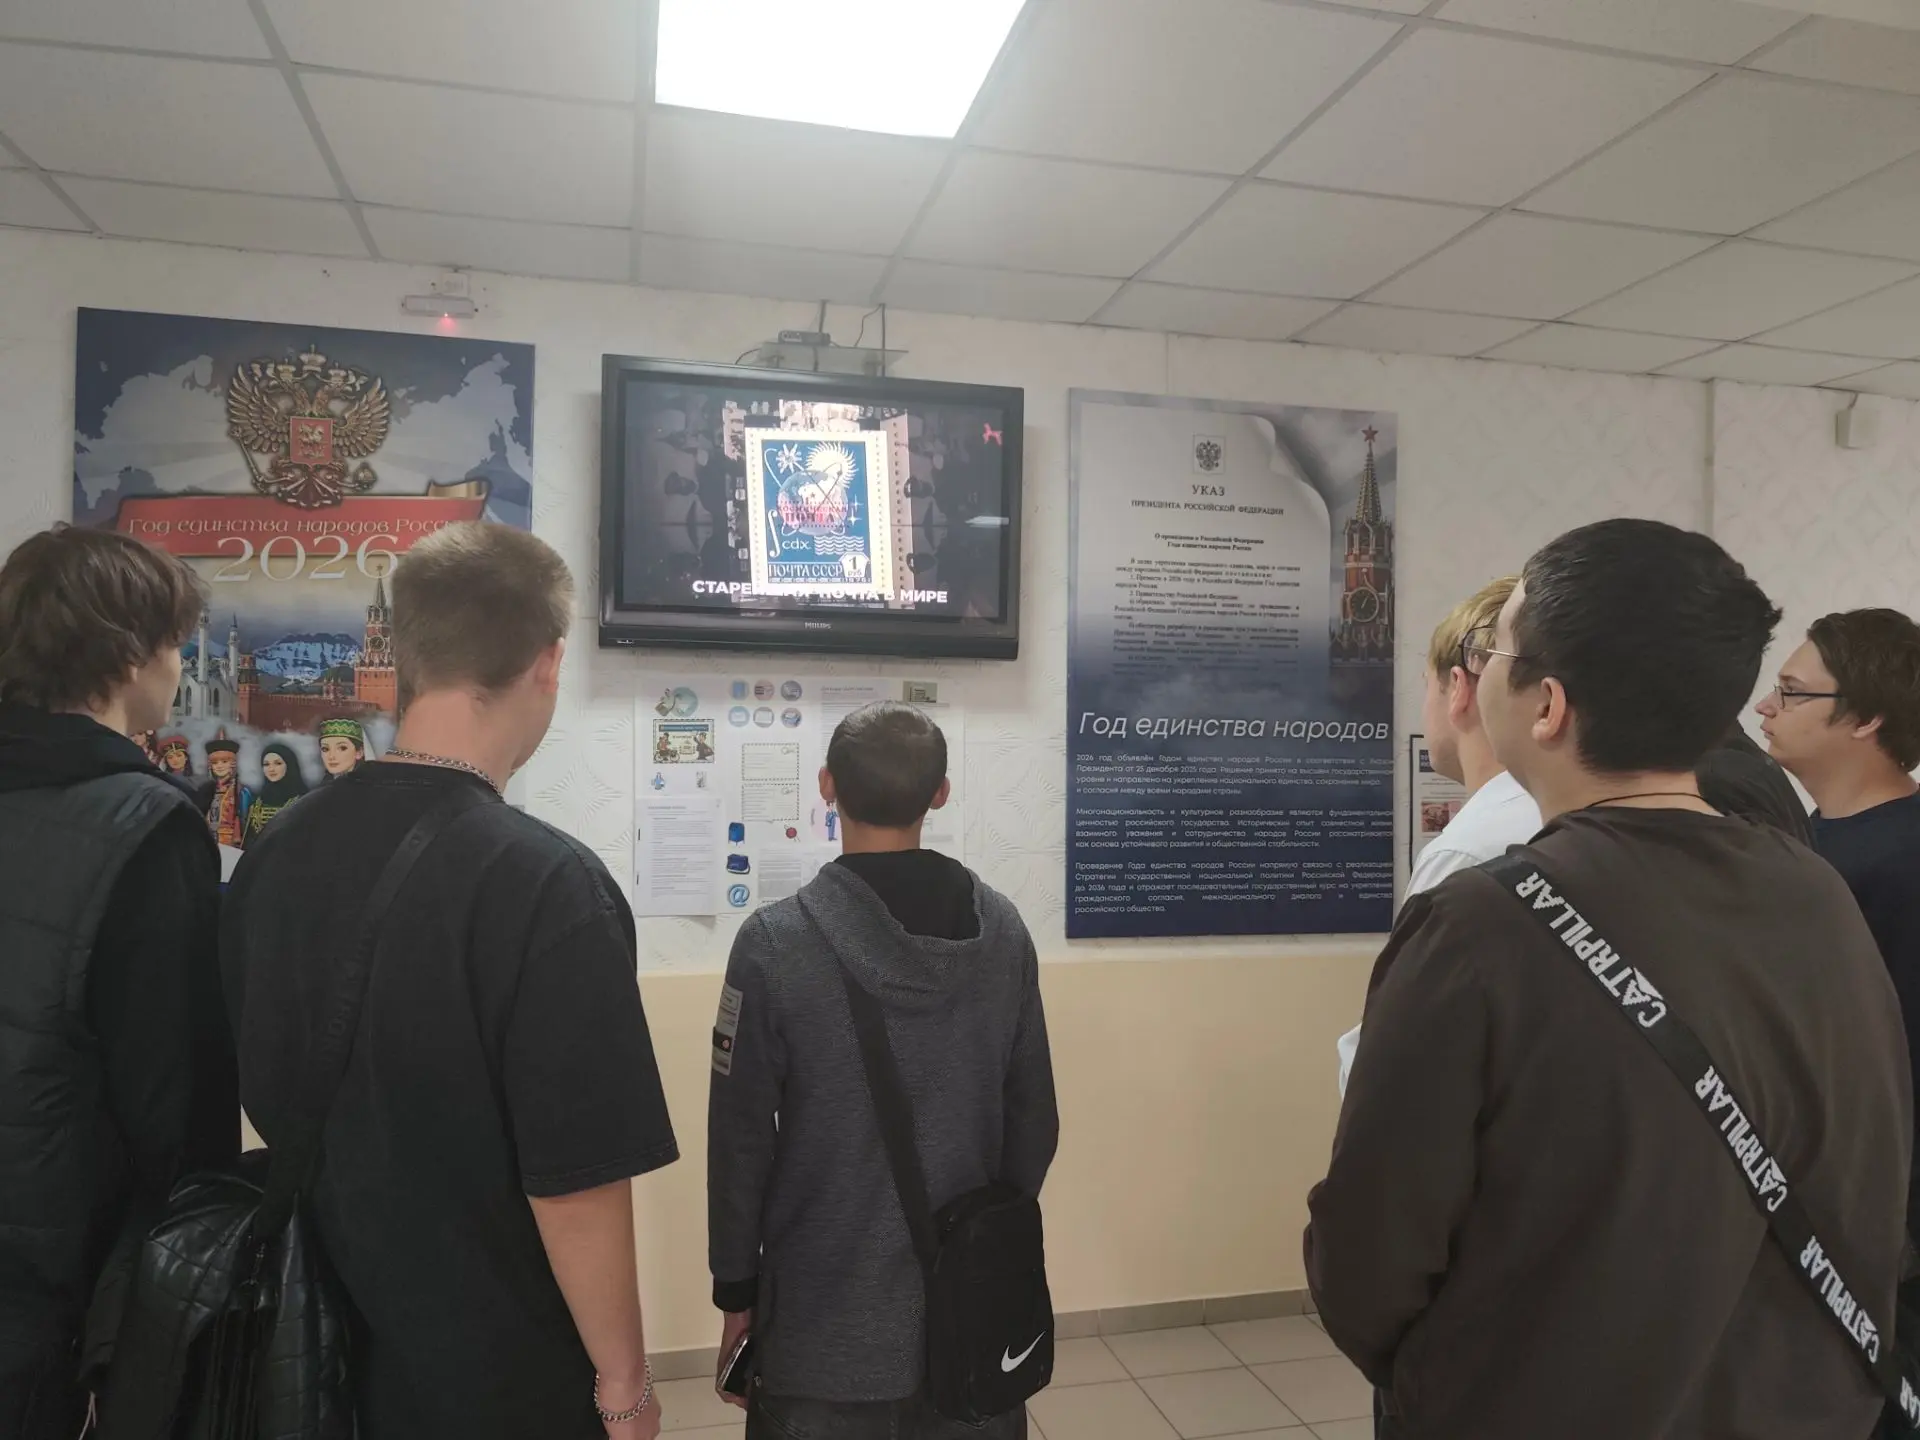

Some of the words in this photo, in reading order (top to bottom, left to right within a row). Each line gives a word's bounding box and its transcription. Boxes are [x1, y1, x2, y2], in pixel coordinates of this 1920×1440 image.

[1191, 484, 1226, 497] УКАЗ
[1131, 500, 1181, 510] ПРЕЗИДЕНТА
[1183, 503, 1235, 513] РОССИЙСКОЙ
[1238, 506, 1284, 516] ФЕДЕРАЦИИ
[129, 518, 170, 534] Год
[177, 518, 289, 536] единства
[297, 518, 390, 536] народов
[396, 518, 449, 533] Росс
[212, 535, 399, 582] 2026
[849, 556, 857, 570] 1
[768, 564, 810, 577] ПОЧТА
[812, 564, 843, 577] СССР
[900, 589, 948, 603] МИРЕ
[1079, 712, 1127, 739] Год
[1135, 716, 1266, 740] единства
[1272, 720, 1389, 743] народов
[1117, 754, 1153, 762] объявлён
[1159, 755, 1181, 763] Годом
[1076, 765, 1123, 773] Президента
[1076, 808, 1164, 816] Многонациональность
[1212, 840, 1266, 848] общественной
[1177, 883, 1248, 891] последовательный
[1075, 895, 1131, 903] гражданского
[1075, 906, 1125, 914] российского
[1516, 871, 1668, 1029] CATRPILLAR
[1694, 1065, 1788, 1213] CATRPILLAR
